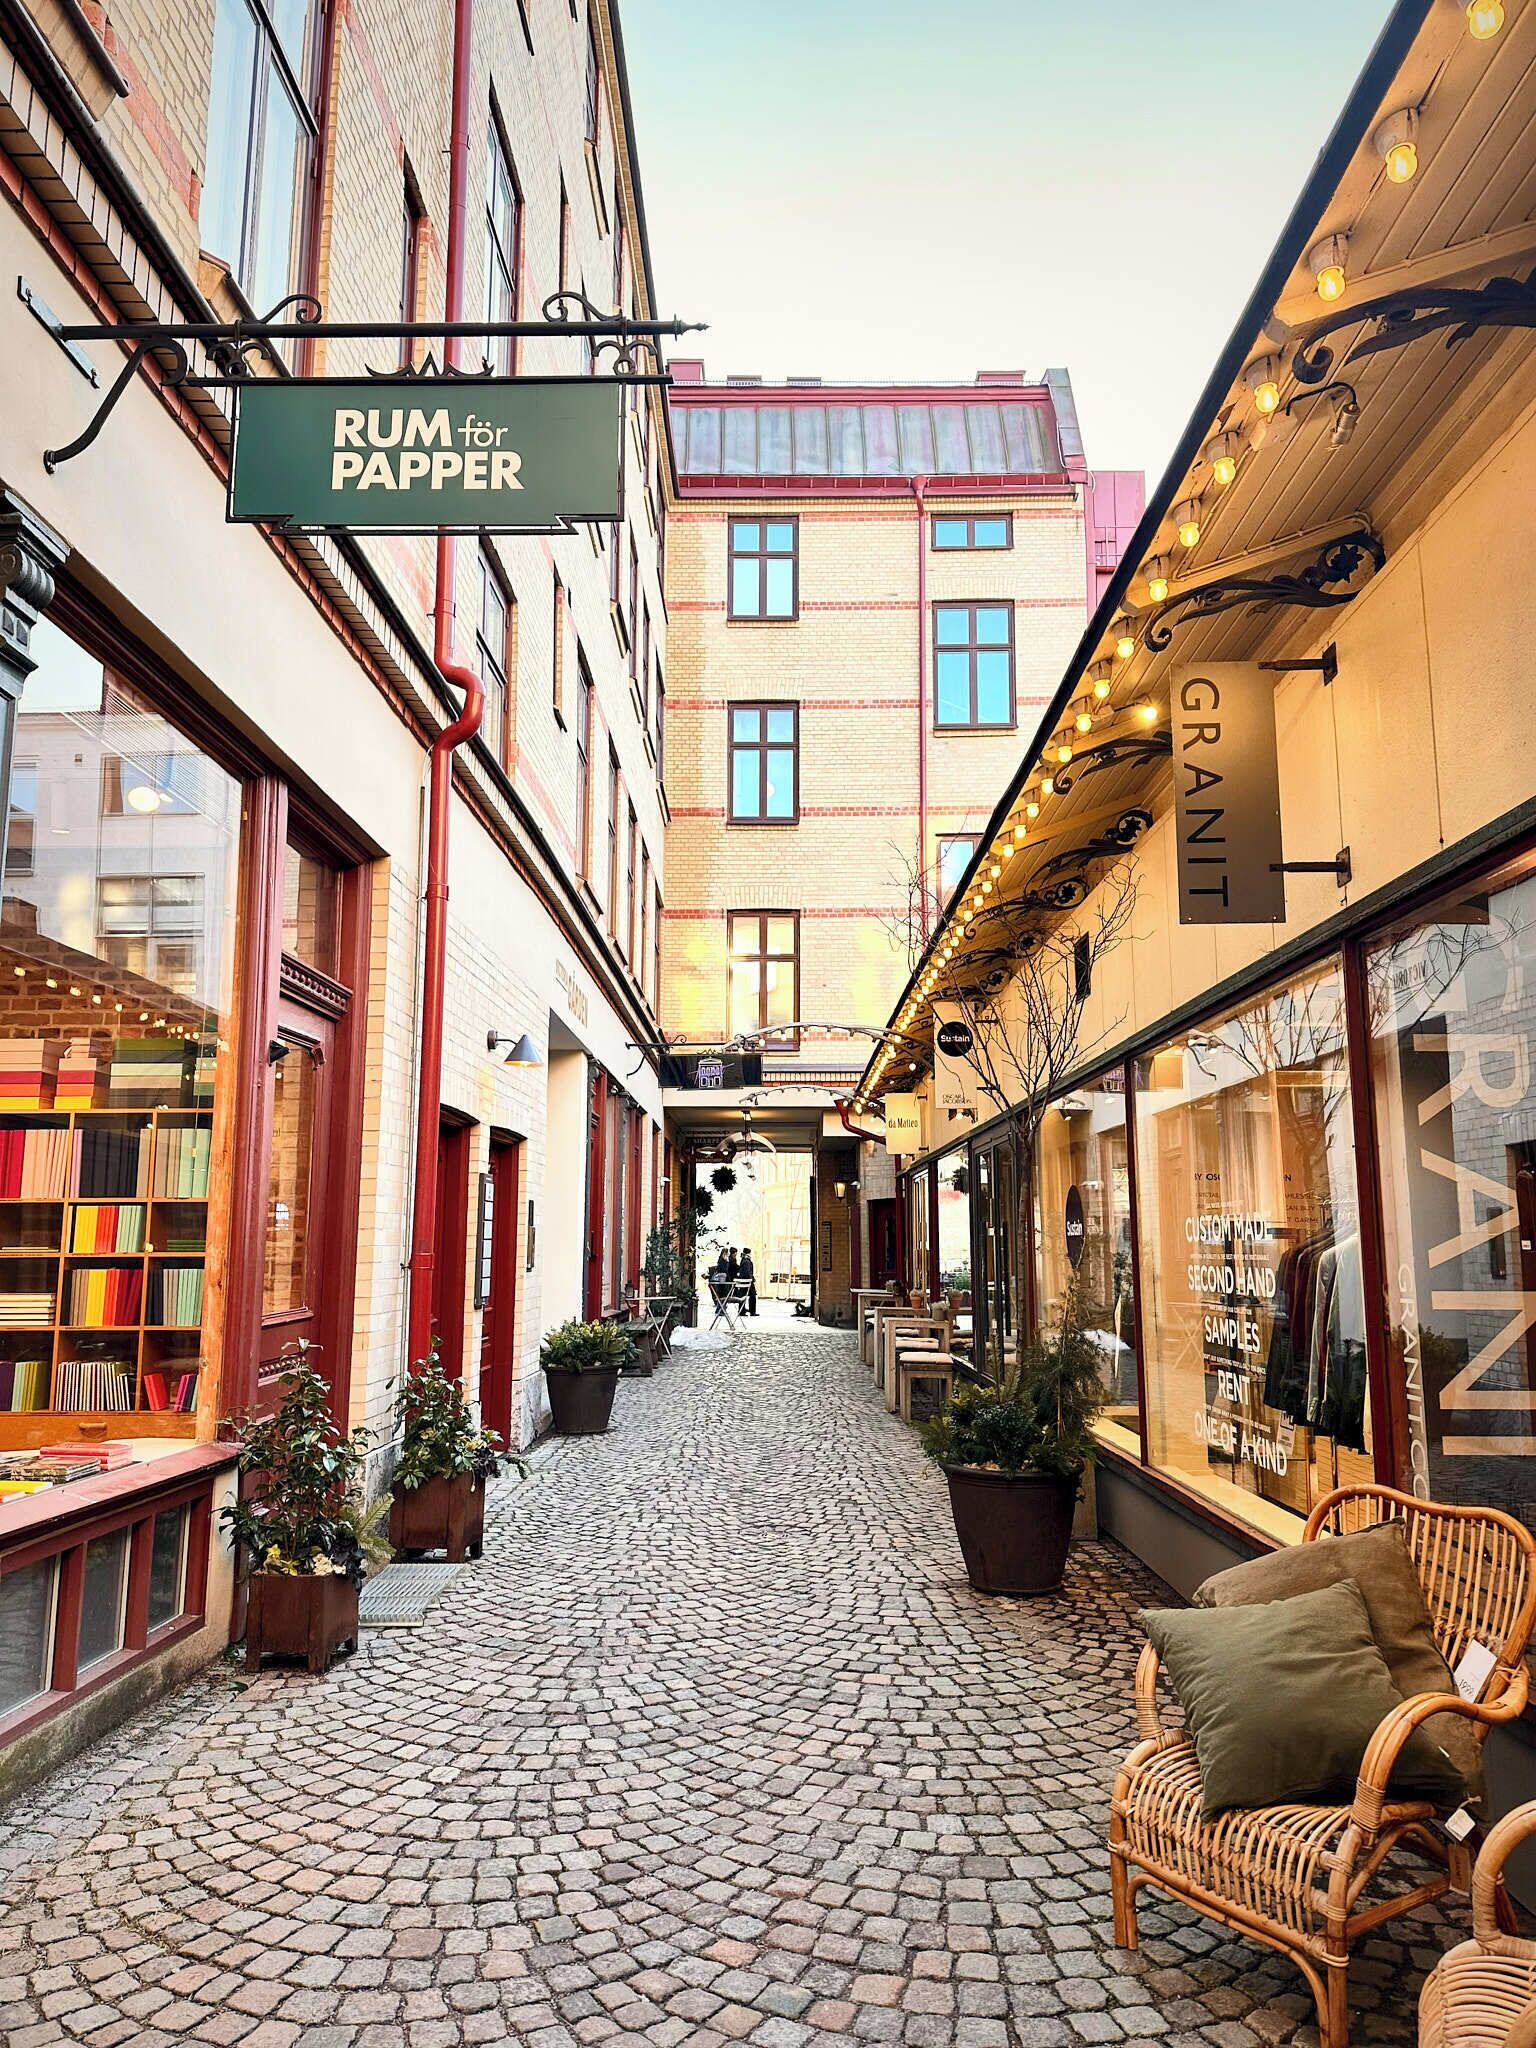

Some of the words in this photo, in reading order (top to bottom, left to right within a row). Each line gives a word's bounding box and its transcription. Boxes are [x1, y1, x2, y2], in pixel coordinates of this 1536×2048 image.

[333, 409, 452, 448] RUM
[457, 414, 509, 447] för
[331, 451, 525, 490] PAPPER
[1180, 677, 1229, 907] GRANIT
[888, 1118, 896, 1128] da
[1066, 1219, 1084, 1237] Sustain
[1185, 1213, 1232, 1243] CUSTOM
[1233, 1210, 1274, 1241] MADE
[1187, 1264, 1235, 1294] SECOND
[1235, 1265, 1277, 1298] HAND
[1204, 1315, 1261, 1353] SAMPLES
[1217, 1369, 1251, 1406] RENT
[1194, 1411, 1220, 1447] ONE
[1219, 1421, 1238, 1454] OF
[1240, 1430, 1251, 1461] A
[1252, 1433, 1288, 1477] KIND
